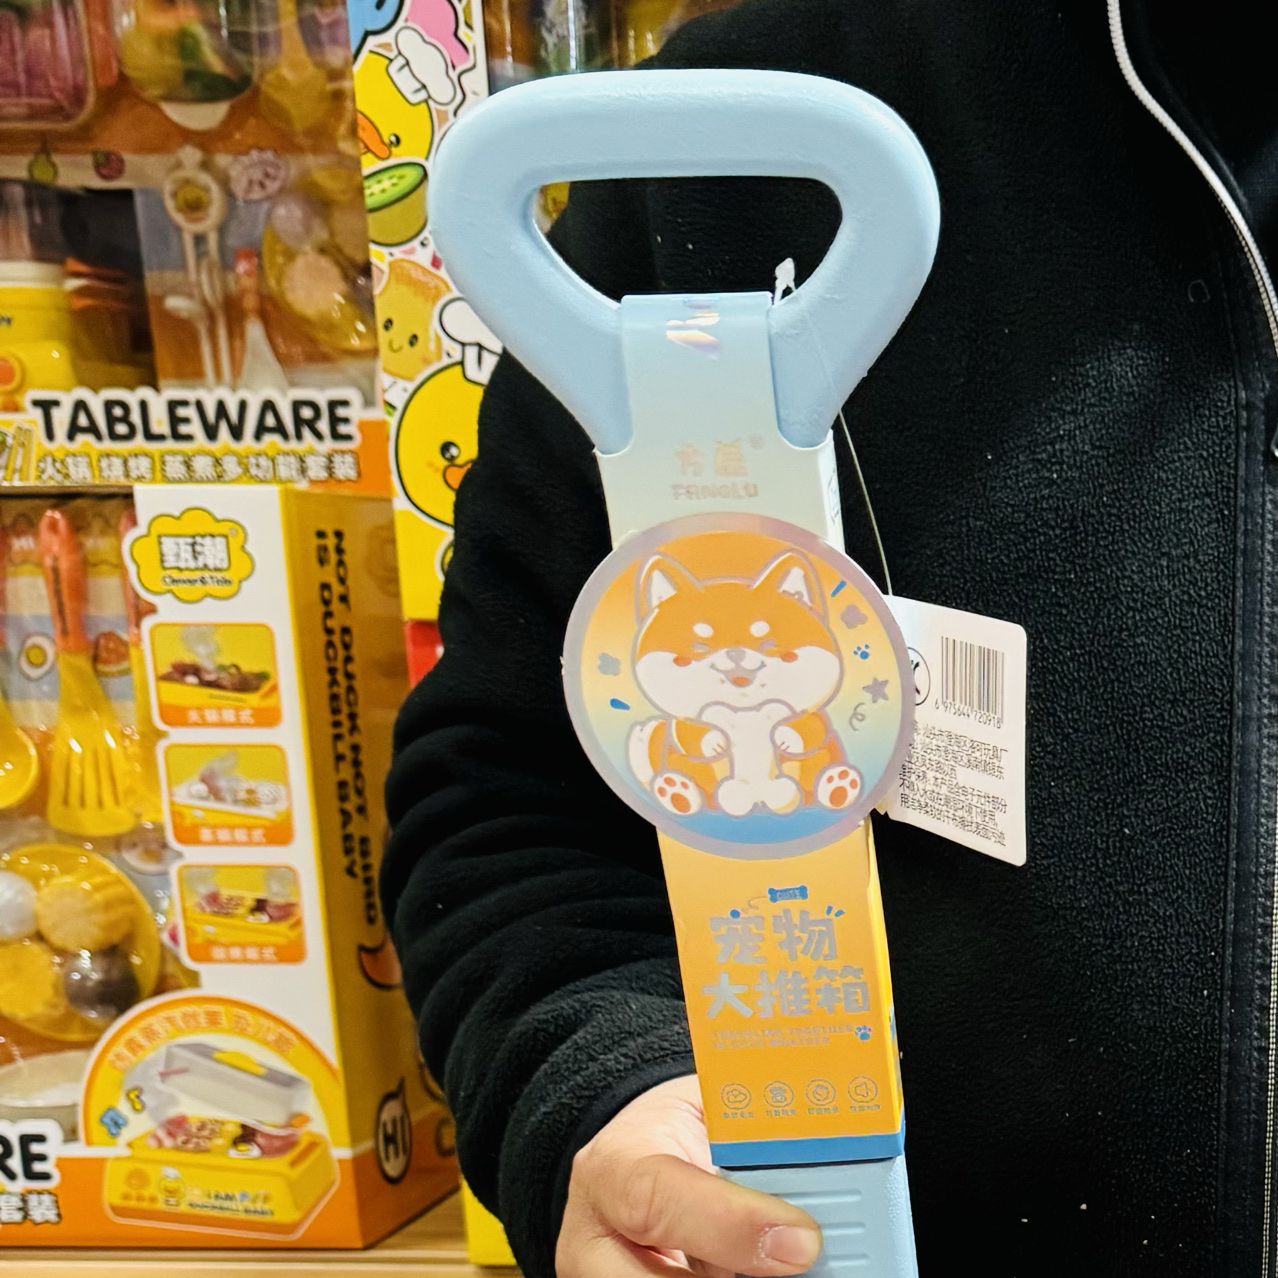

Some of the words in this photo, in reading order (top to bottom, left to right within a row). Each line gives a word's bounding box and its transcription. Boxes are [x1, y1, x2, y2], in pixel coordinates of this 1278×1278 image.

[32, 399, 354, 442] TABLEWARE
[709, 908, 839, 965] 宠物
[702, 965, 871, 1019] 大推箱
